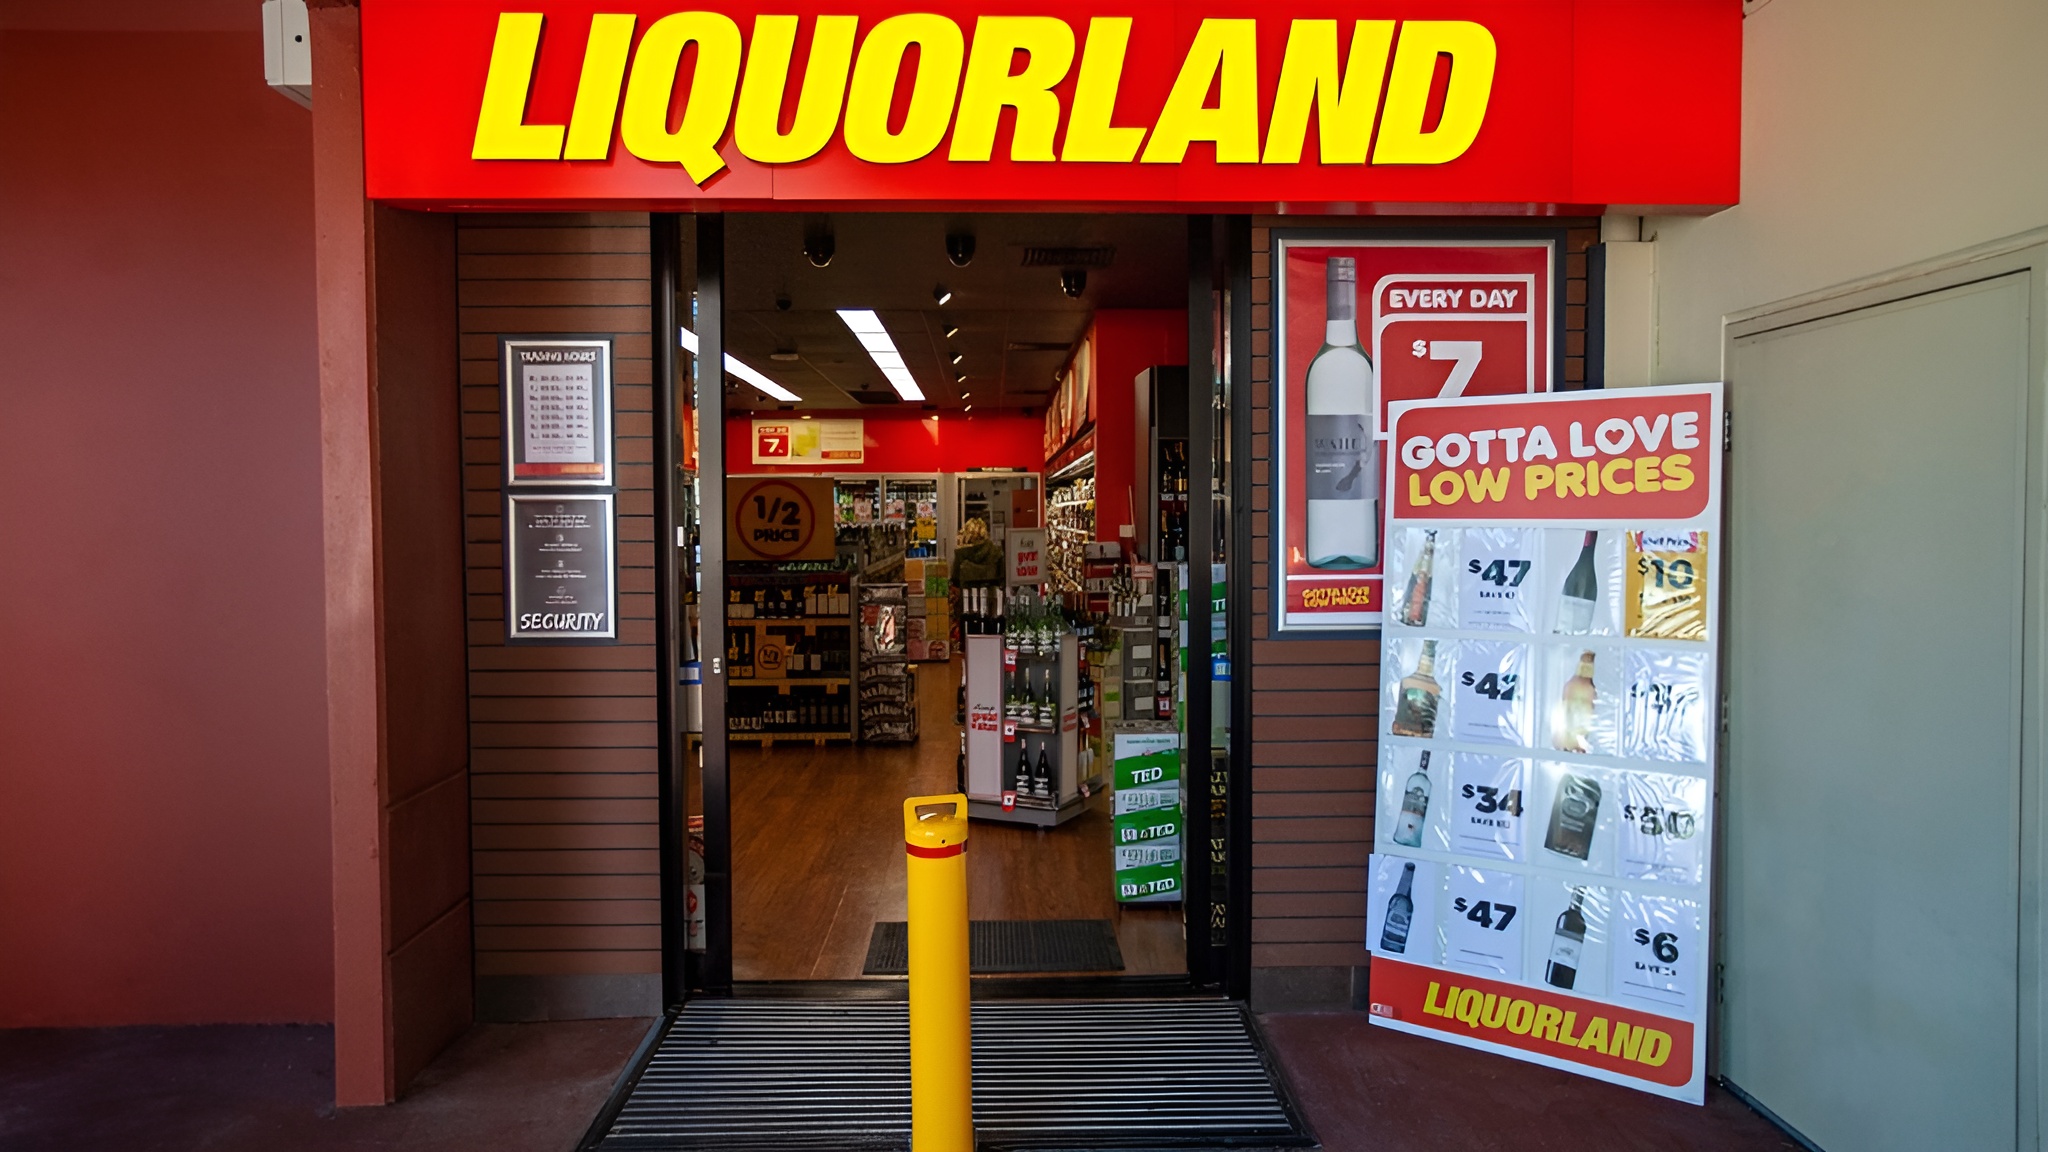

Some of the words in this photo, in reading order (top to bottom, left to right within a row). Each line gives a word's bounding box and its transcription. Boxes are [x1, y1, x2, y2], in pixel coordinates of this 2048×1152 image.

[472, 12, 1497, 187] LIQUORLAND
[1389, 289, 1462, 308] EVERY
[1470, 289, 1518, 308] DAY
[1401, 425, 1557, 470] GOTTA
[1569, 411, 1700, 457] LOVE
[1409, 467, 1511, 506] LOW
[1525, 454, 1695, 500] PRICES
[753, 495, 801, 525] 1/2
[754, 529, 799, 543] PRICE
[1468, 559, 1532, 588] $47
[1638, 557, 1694, 589] $10
[520, 613, 604, 631] SECURITY
[1131, 766, 1163, 784] TED
[1461, 783, 1524, 818] $34
[1453, 896, 1516, 932] $47
[1634, 928, 1679, 964] $6
[1423, 981, 1672, 1067] LIQUORLAND
